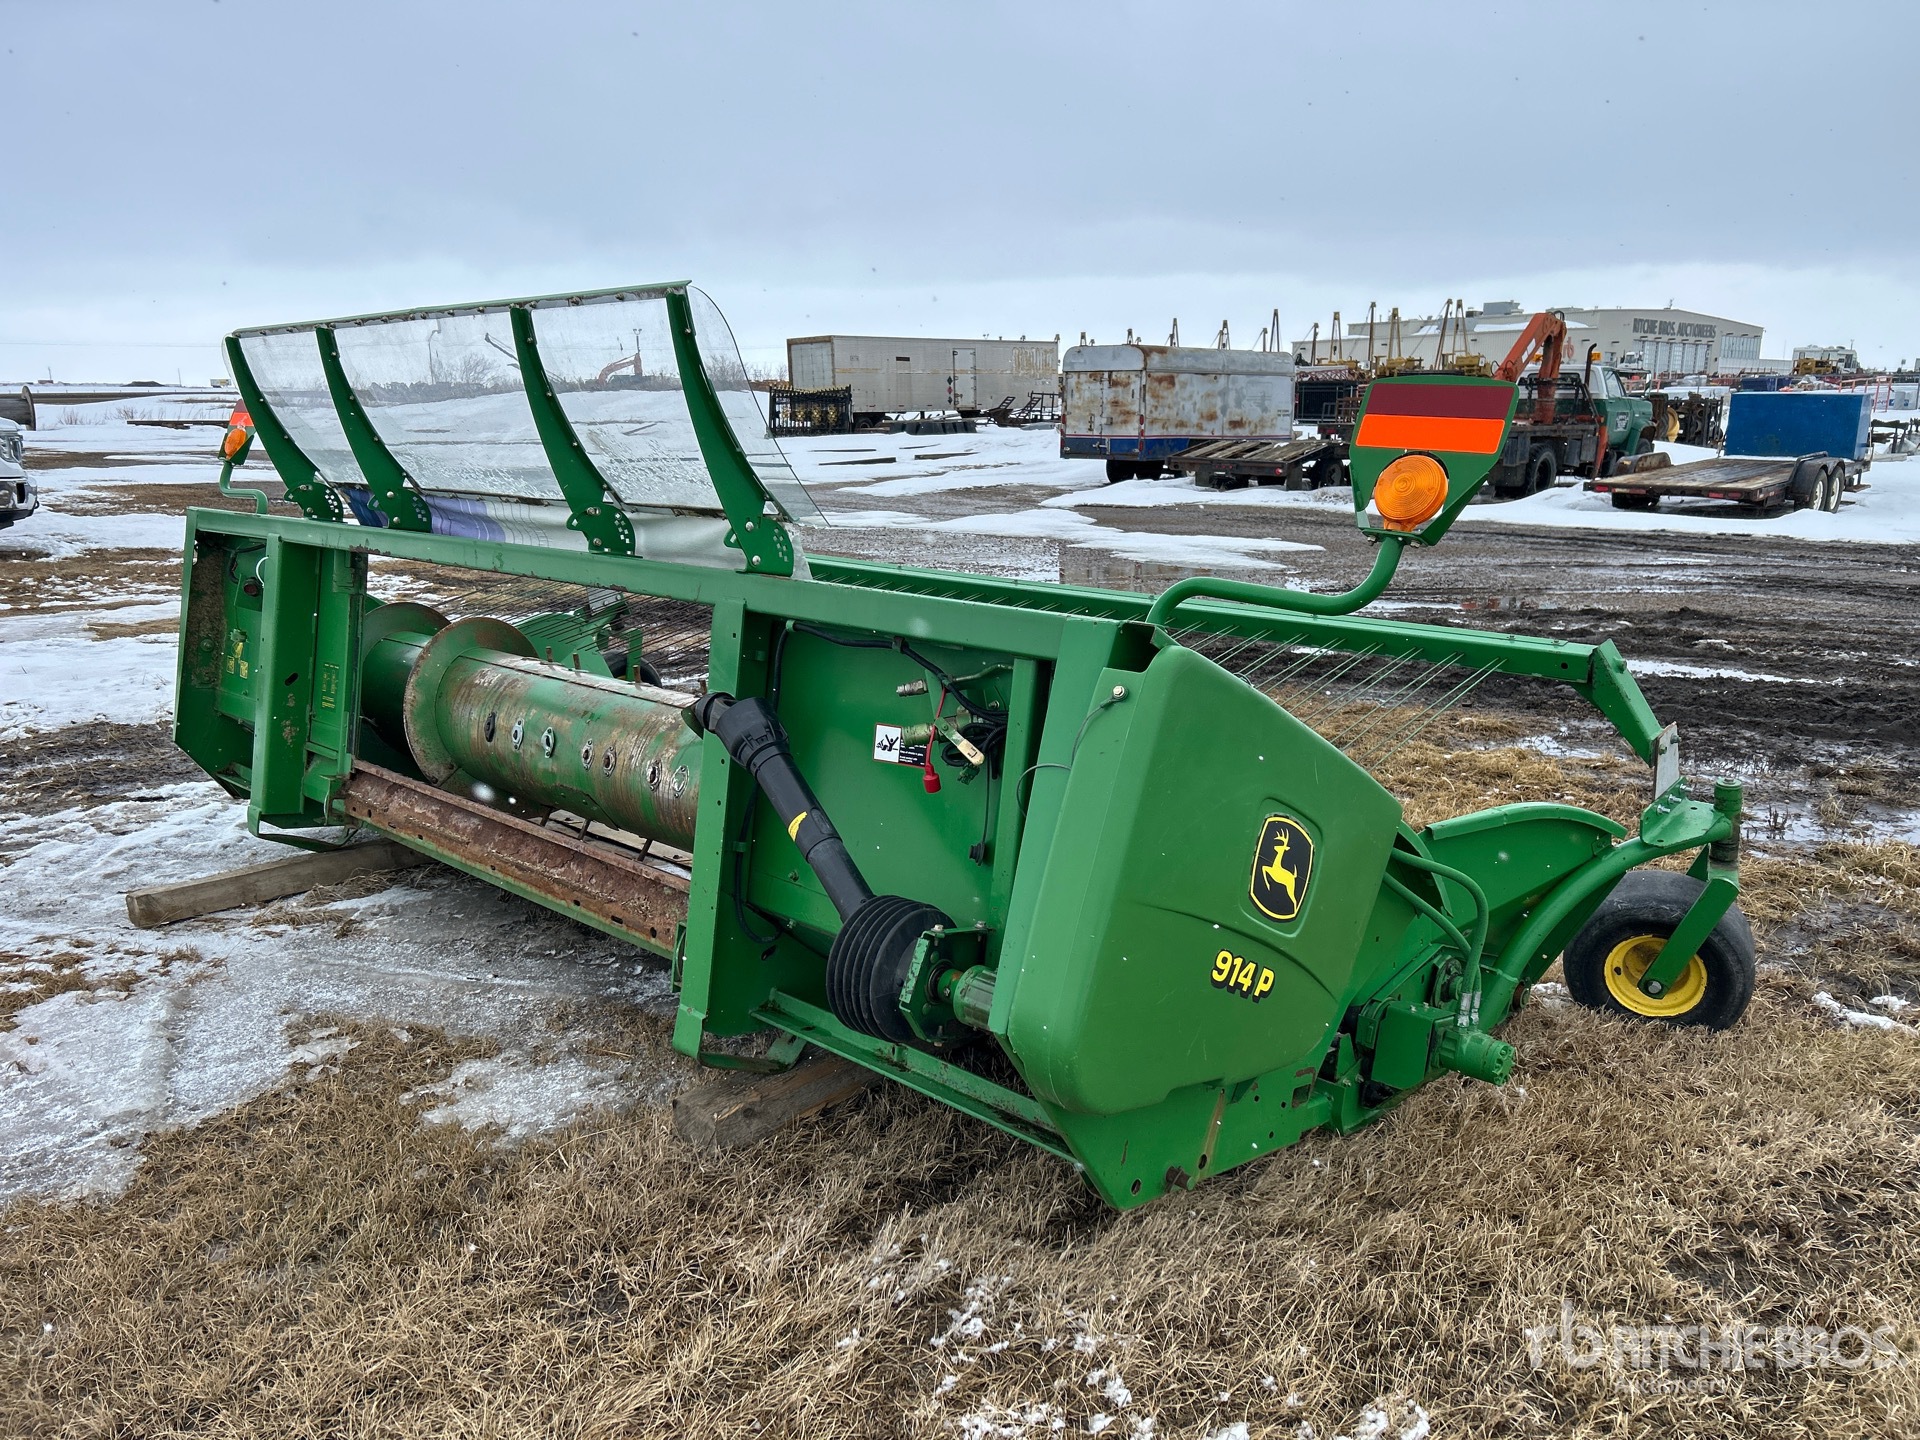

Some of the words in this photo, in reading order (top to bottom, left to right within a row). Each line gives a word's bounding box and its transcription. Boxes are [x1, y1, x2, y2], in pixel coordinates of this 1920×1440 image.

[1633, 317, 1658, 334] RITCHIE
[1658, 320, 1676, 336] BROS.
[1677, 321, 1717, 339] AUCTIONEERS
[1211, 949, 1275, 1003] 914P
